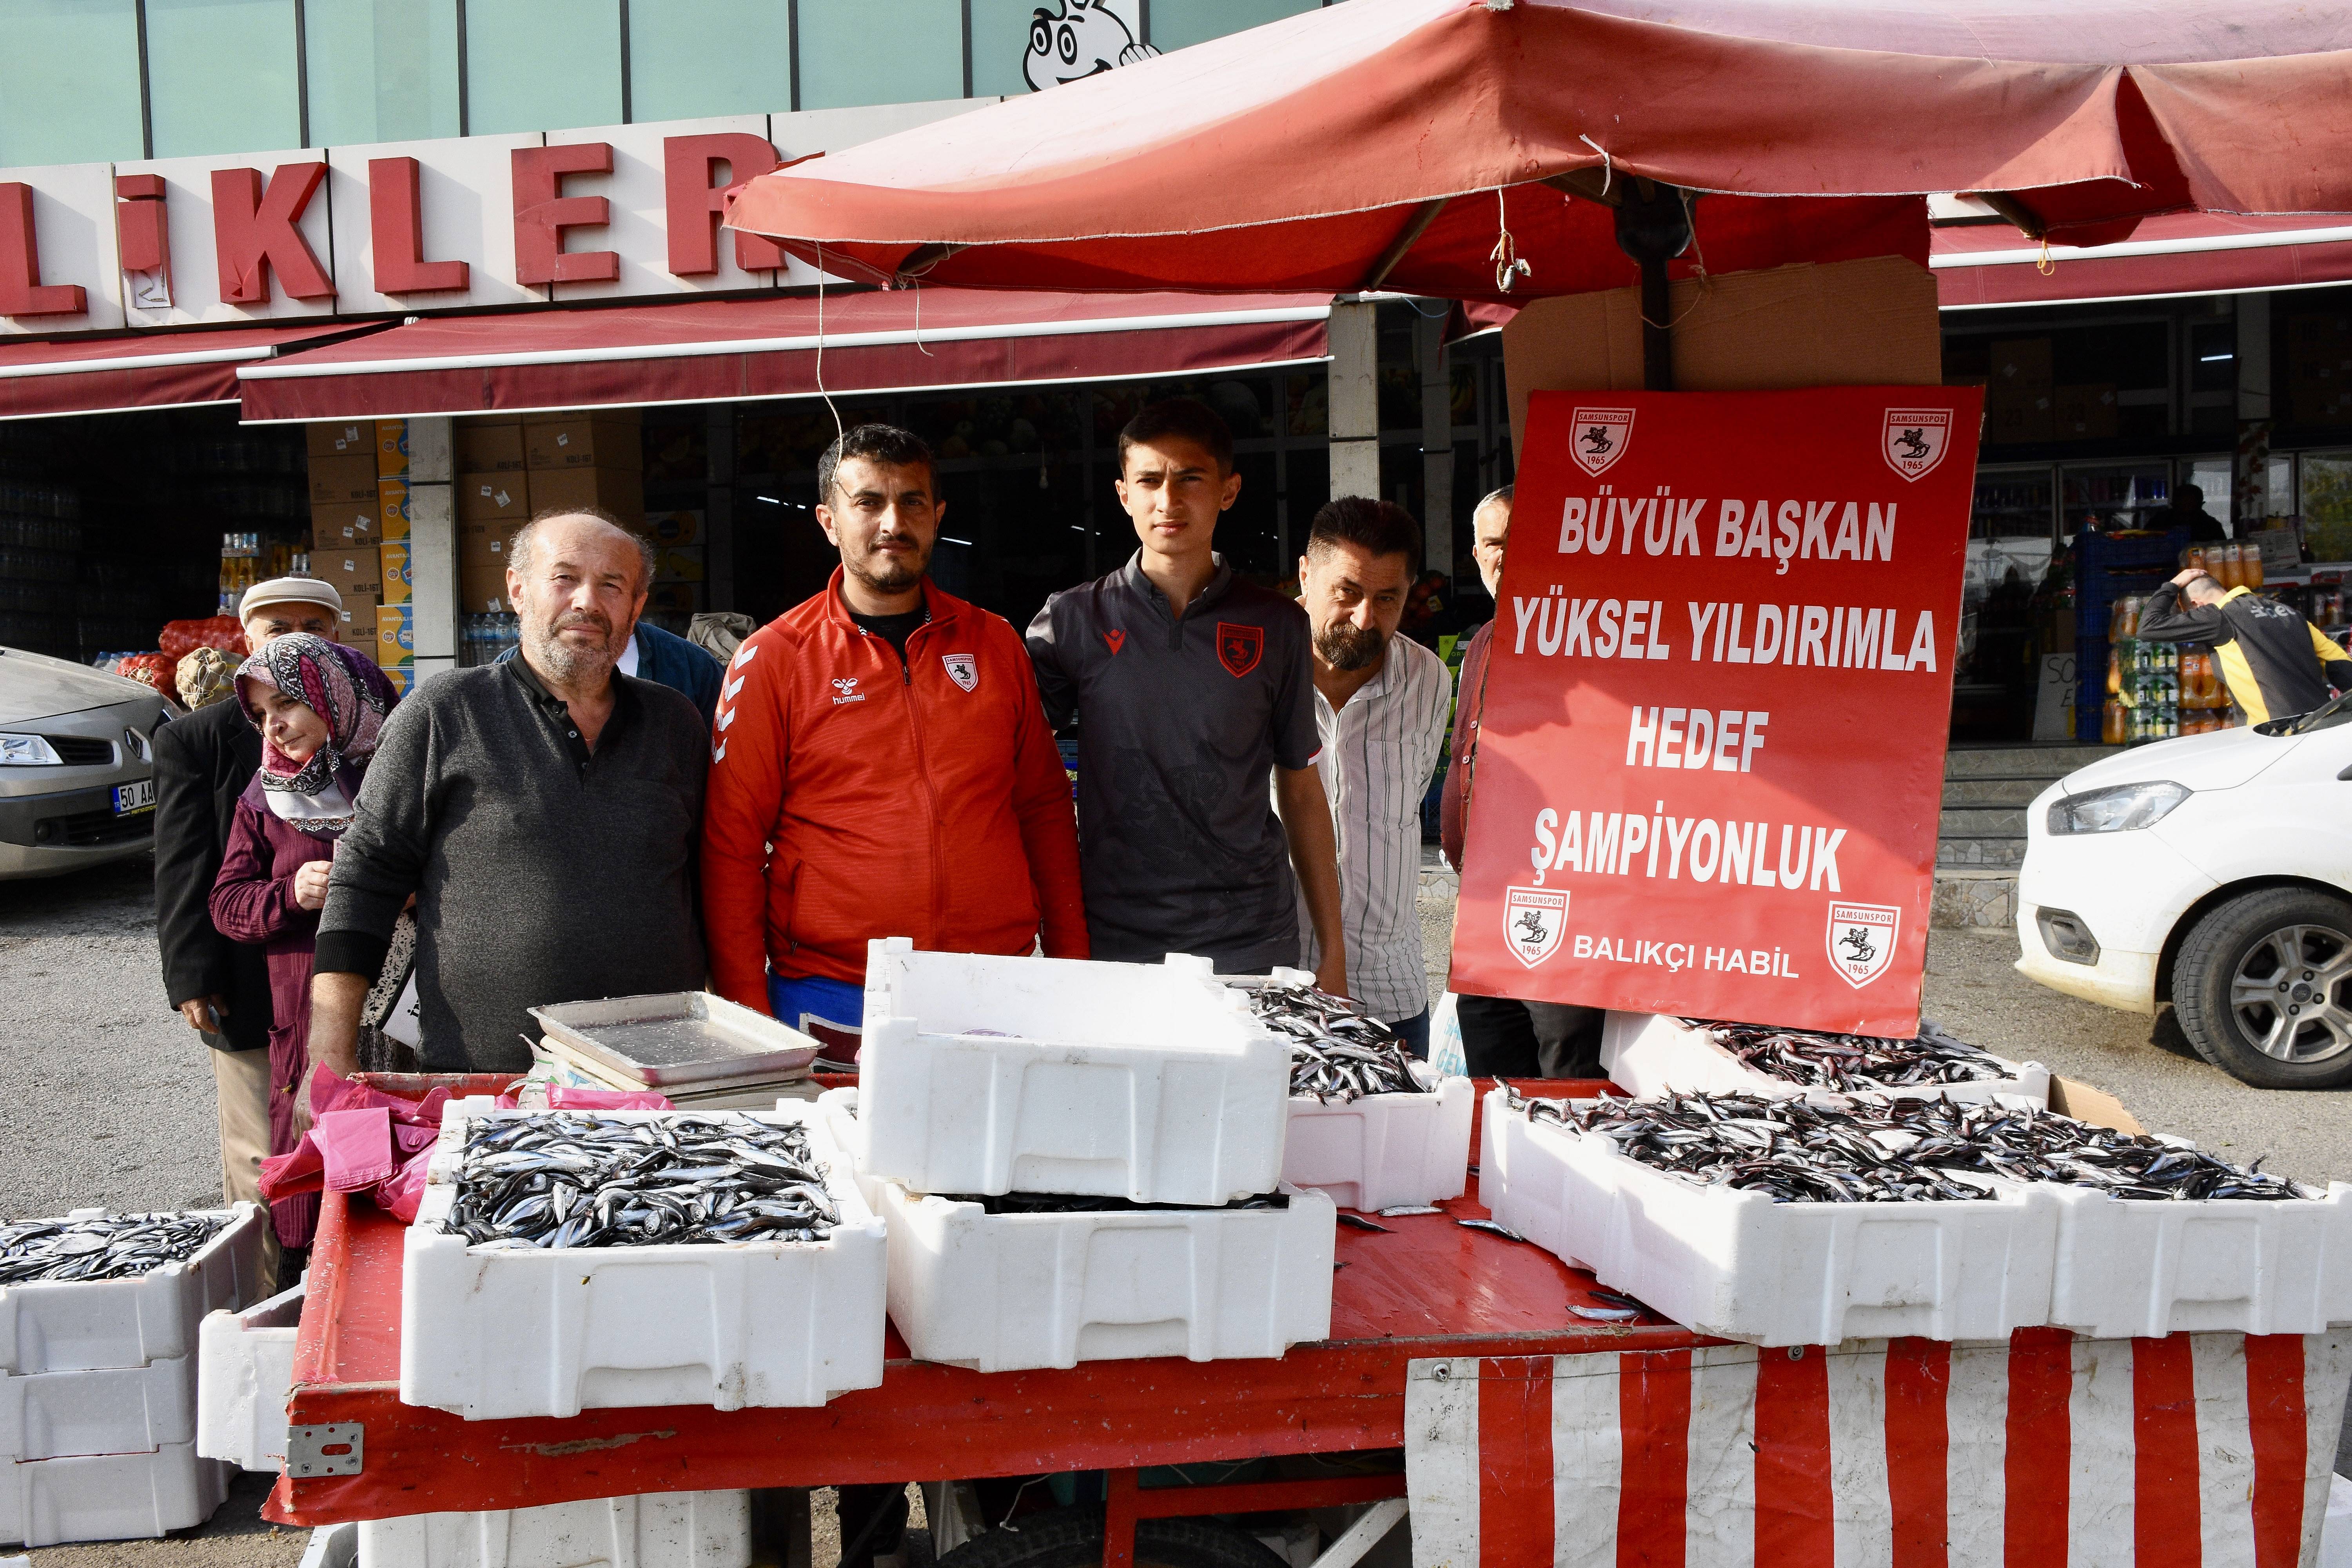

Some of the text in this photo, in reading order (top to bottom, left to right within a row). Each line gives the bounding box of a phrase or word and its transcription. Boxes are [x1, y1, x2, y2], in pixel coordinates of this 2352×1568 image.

[1587, 456, 1605, 464] 1965
[1903, 461, 1923, 469] 1965
[1558, 485, 1896, 575] BÜYÜK BAŞKAN
[1514, 585, 1936, 672] YÜKSEL YILDIRIMLA
[833, 692, 865, 705] hummel
[1626, 706, 1769, 773] HEDEF
[120, 787, 134, 808] 50
[142, 782, 153, 804] AA
[1531, 800, 1847, 893] ŞAMPİYONLUK
[1513, 895, 1562, 906] SAMSUNSPOR
[1836, 910, 1892, 922] SAMSUNSPOR
[1523, 945, 1541, 955] 1965
[1573, 935, 1799, 978] BALIKÇI HABİL
[1848, 964, 1869, 975] 1965
